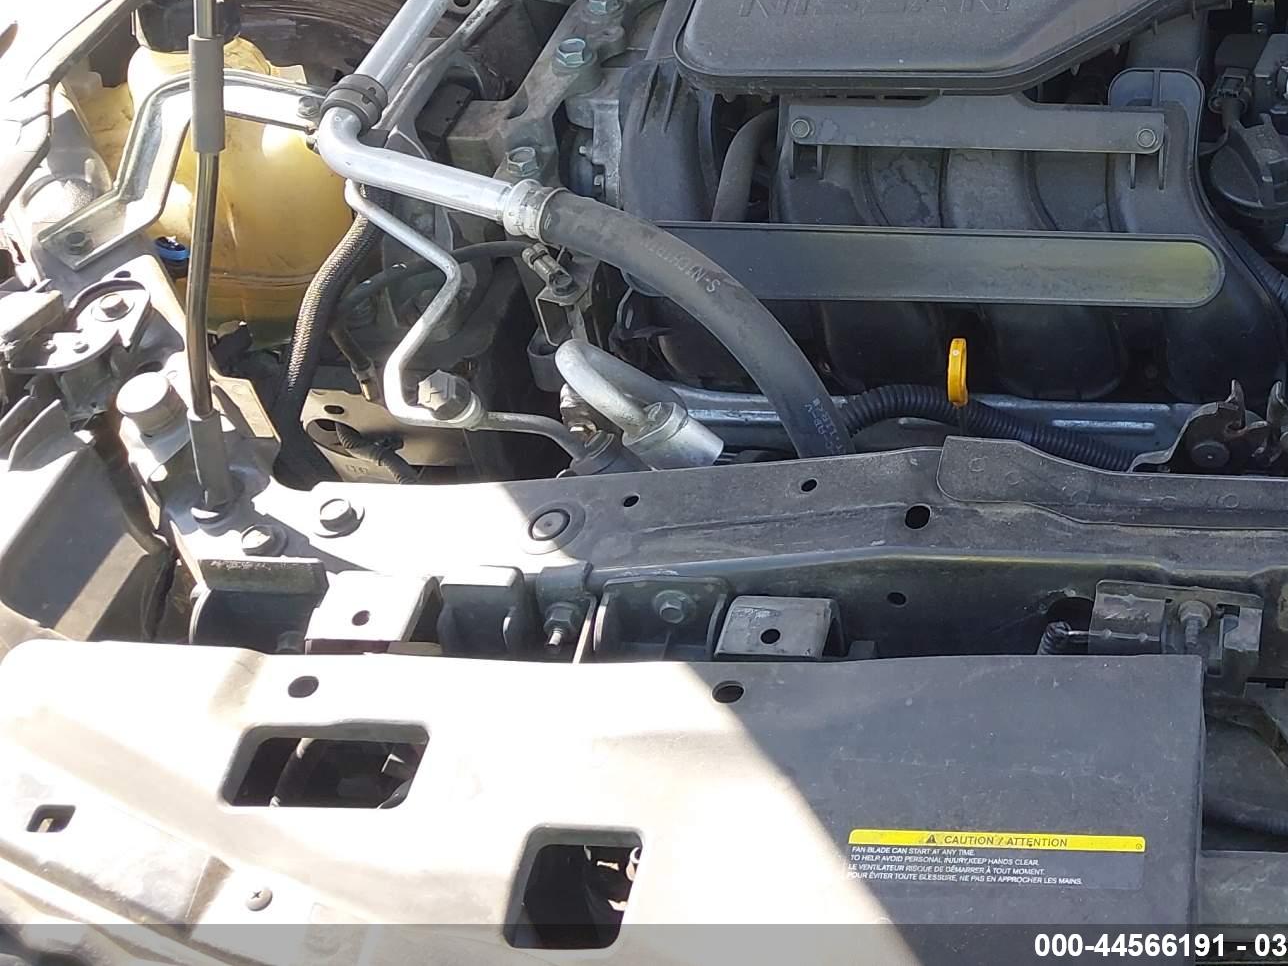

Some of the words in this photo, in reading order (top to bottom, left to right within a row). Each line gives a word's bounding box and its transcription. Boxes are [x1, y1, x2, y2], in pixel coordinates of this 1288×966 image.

[944, 835, 994, 845] CAUTION
[998, 837, 1005, 846] /
[1006, 837, 1068, 848] ATTENTION
[904, 856, 942, 864] PERSONAL
[945, 865, 985, 874] DÉMARRER
[985, 865, 991, 874] À
[993, 867, 1011, 875] TOUT
[869, 871, 893, 879] ÉVITER
[918, 874, 958, 882] BLESSURE,
[1058, 877, 1082, 885] MAINS.
